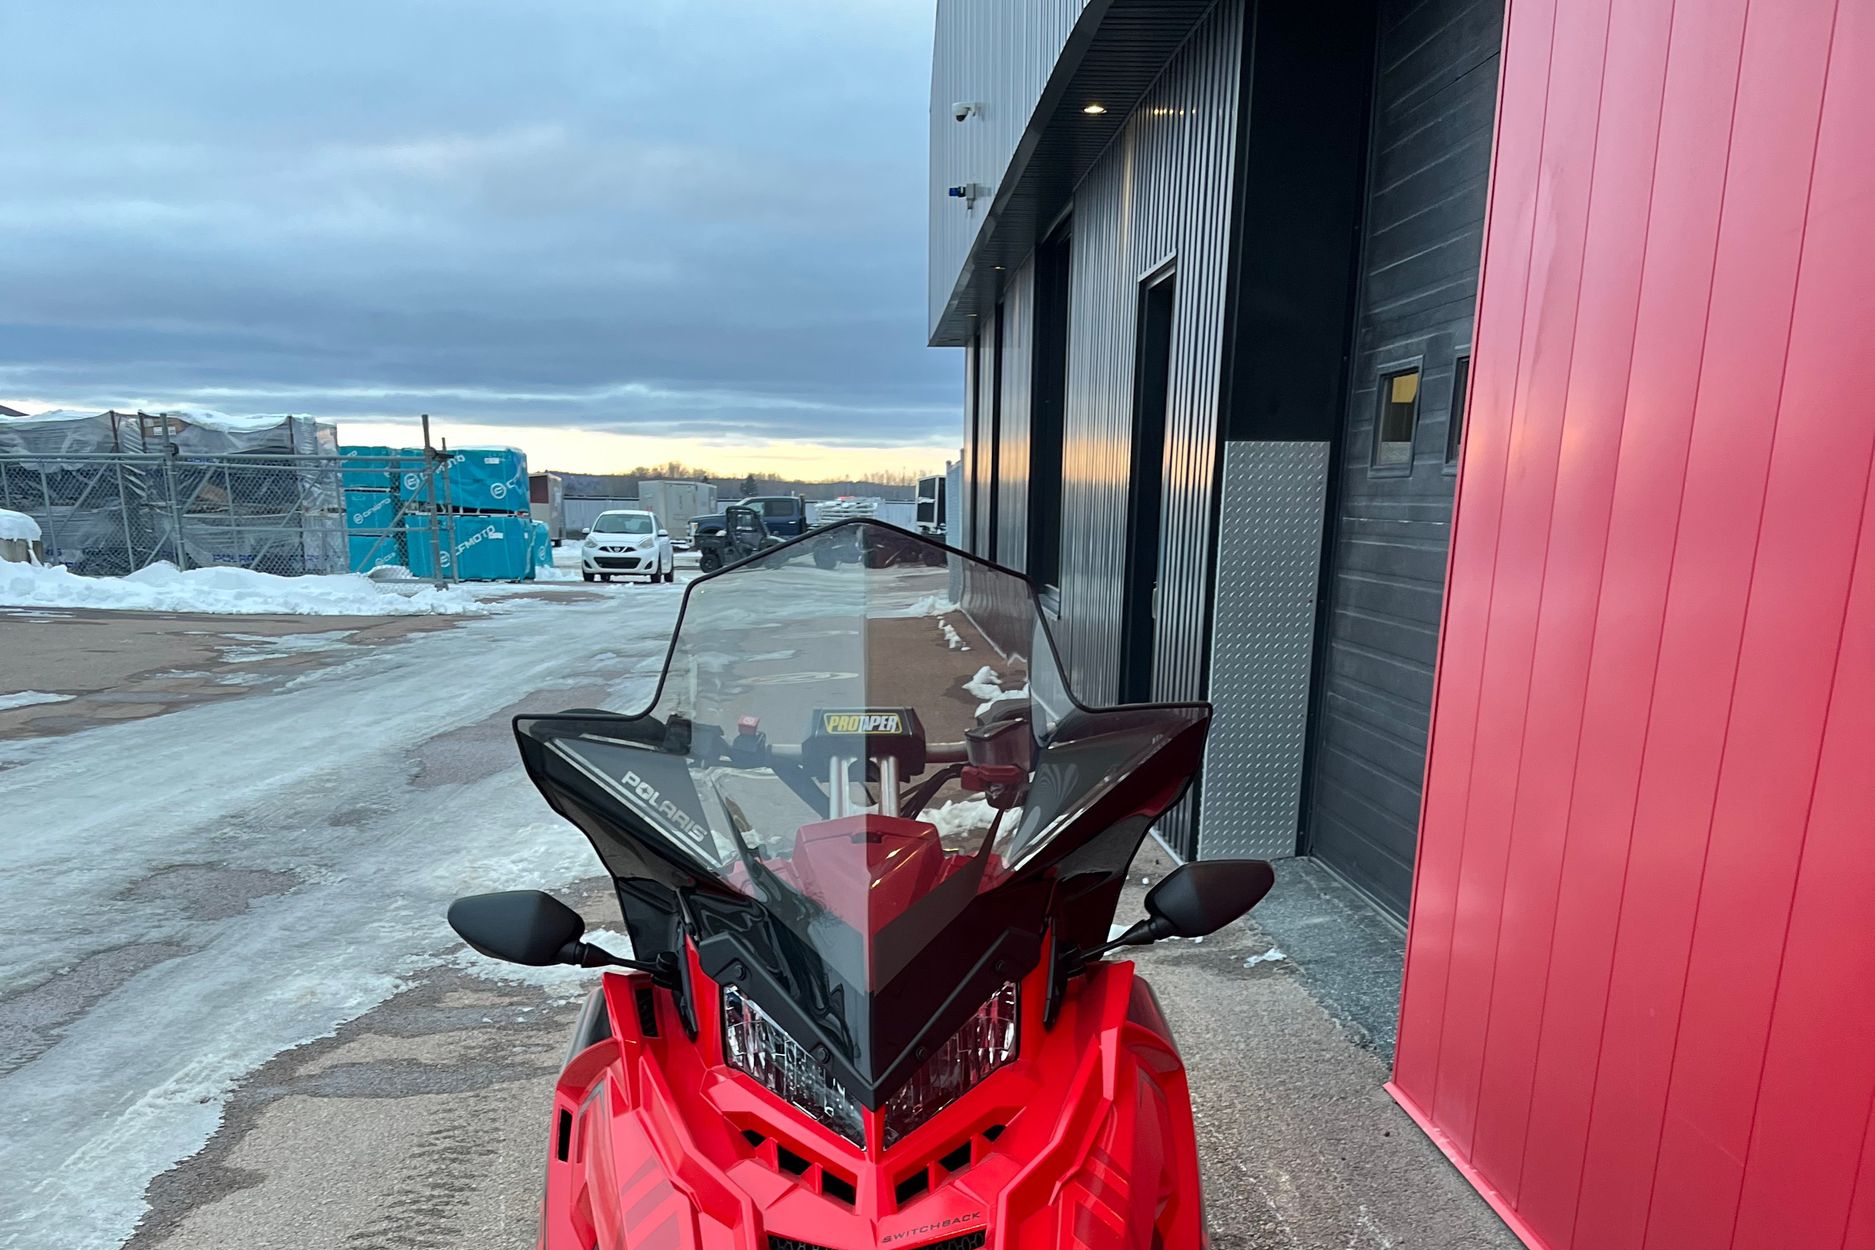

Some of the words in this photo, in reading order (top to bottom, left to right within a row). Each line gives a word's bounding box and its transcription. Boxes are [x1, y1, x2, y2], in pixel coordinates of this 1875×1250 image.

[827, 715, 899, 733] PROTAPER
[621, 770, 708, 843] POLARIS
[882, 1211, 981, 1243] SWITCHBACK
